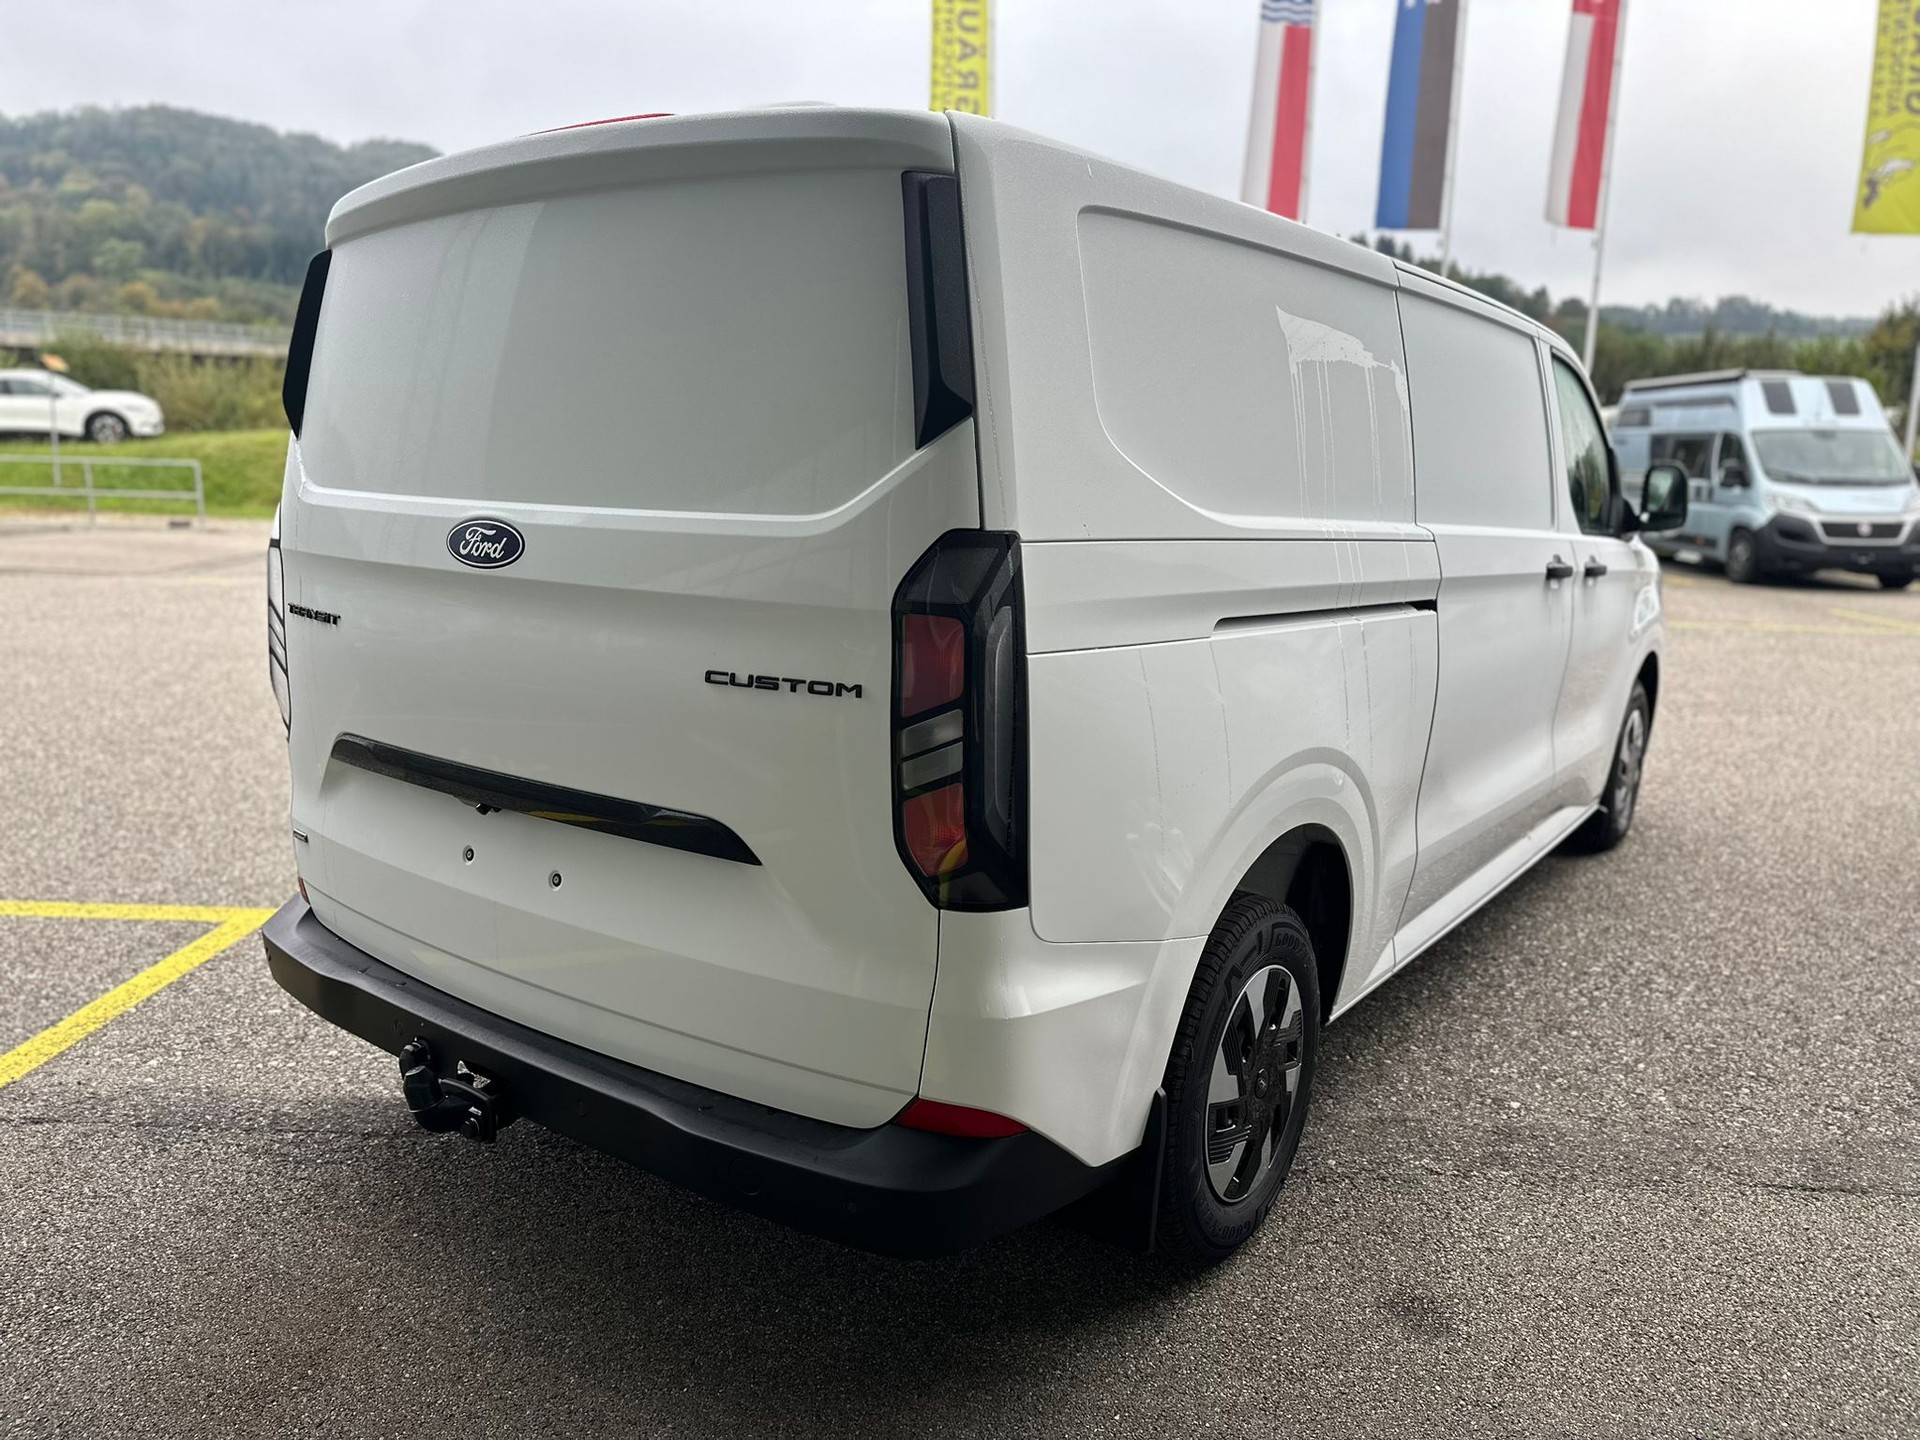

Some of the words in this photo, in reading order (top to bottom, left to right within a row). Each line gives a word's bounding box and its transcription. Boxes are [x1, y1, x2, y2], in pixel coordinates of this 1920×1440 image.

[459, 526, 507, 558] Ford
[288, 603, 341, 626] TRANSIT
[705, 670, 862, 699] CUSTOM
